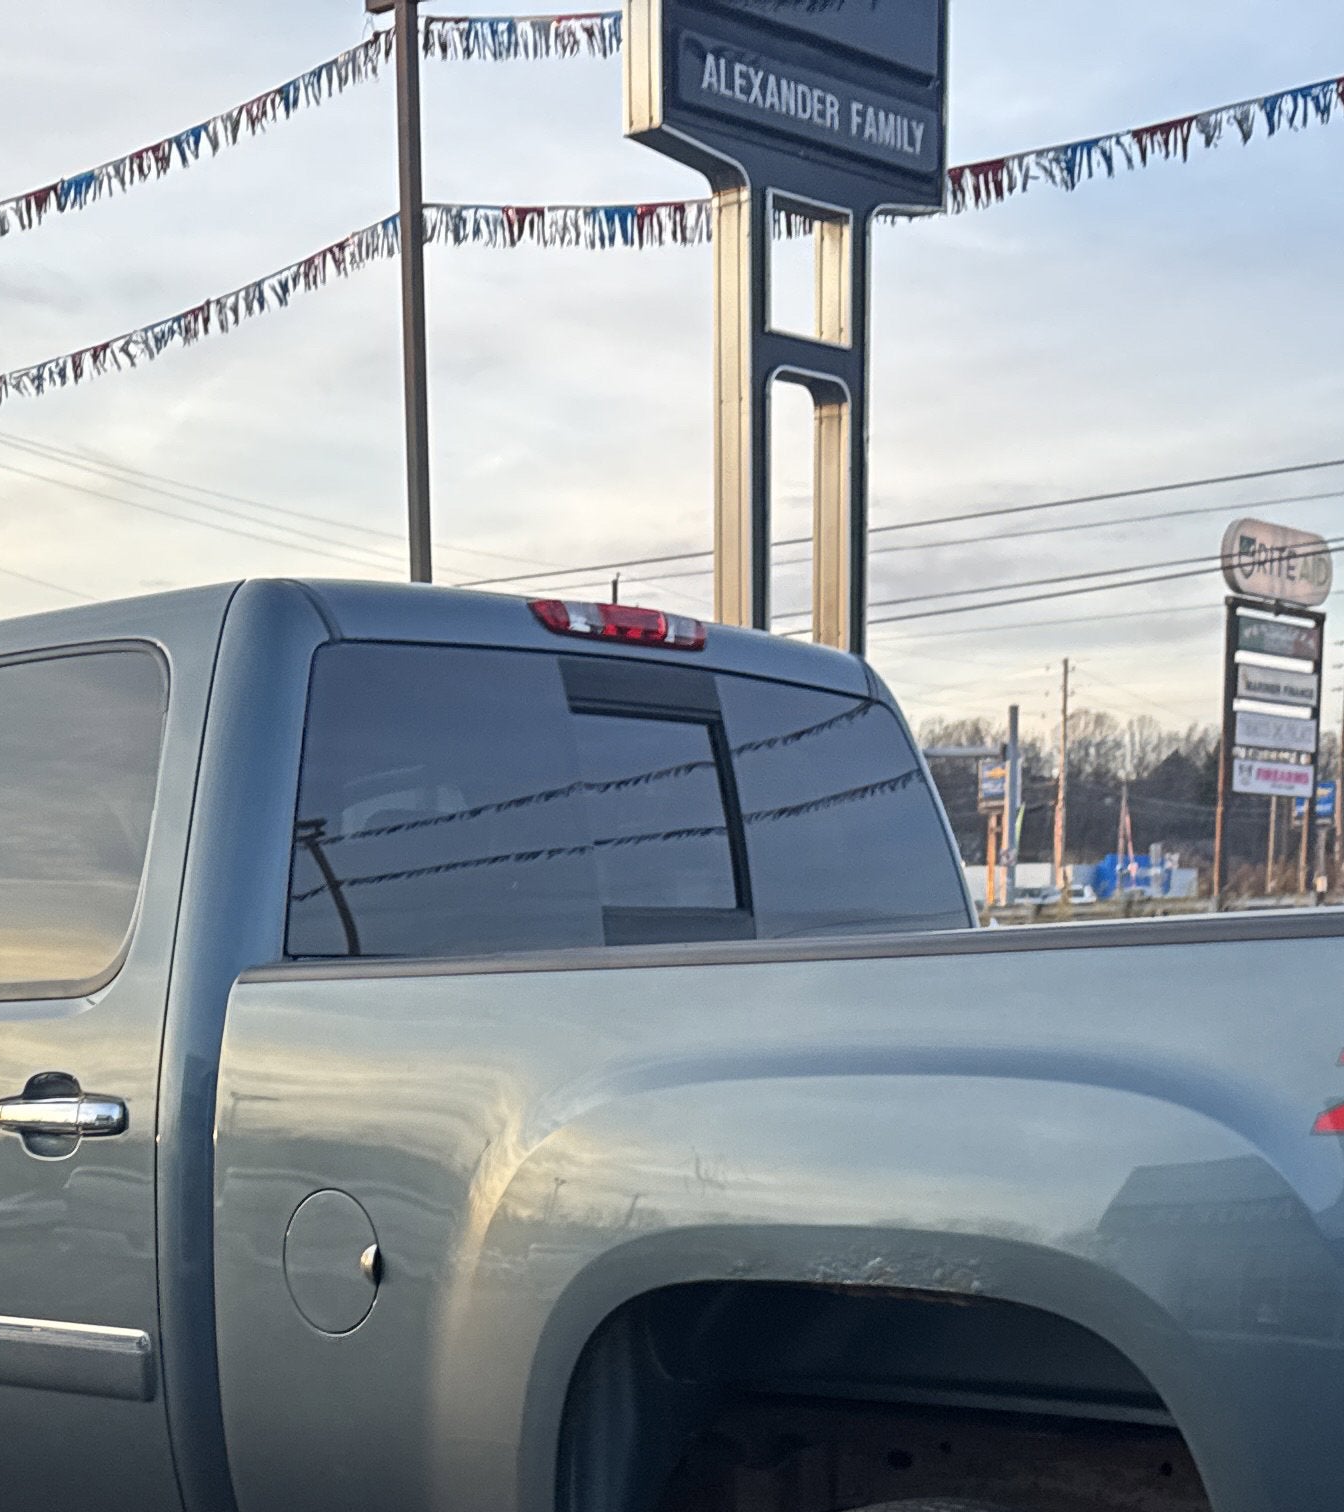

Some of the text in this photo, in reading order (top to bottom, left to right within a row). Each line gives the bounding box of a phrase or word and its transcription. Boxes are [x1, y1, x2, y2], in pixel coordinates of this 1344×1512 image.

[701, 53, 926, 156] ALEXANDER FAMILY
[1257, 543, 1296, 582] RITE
